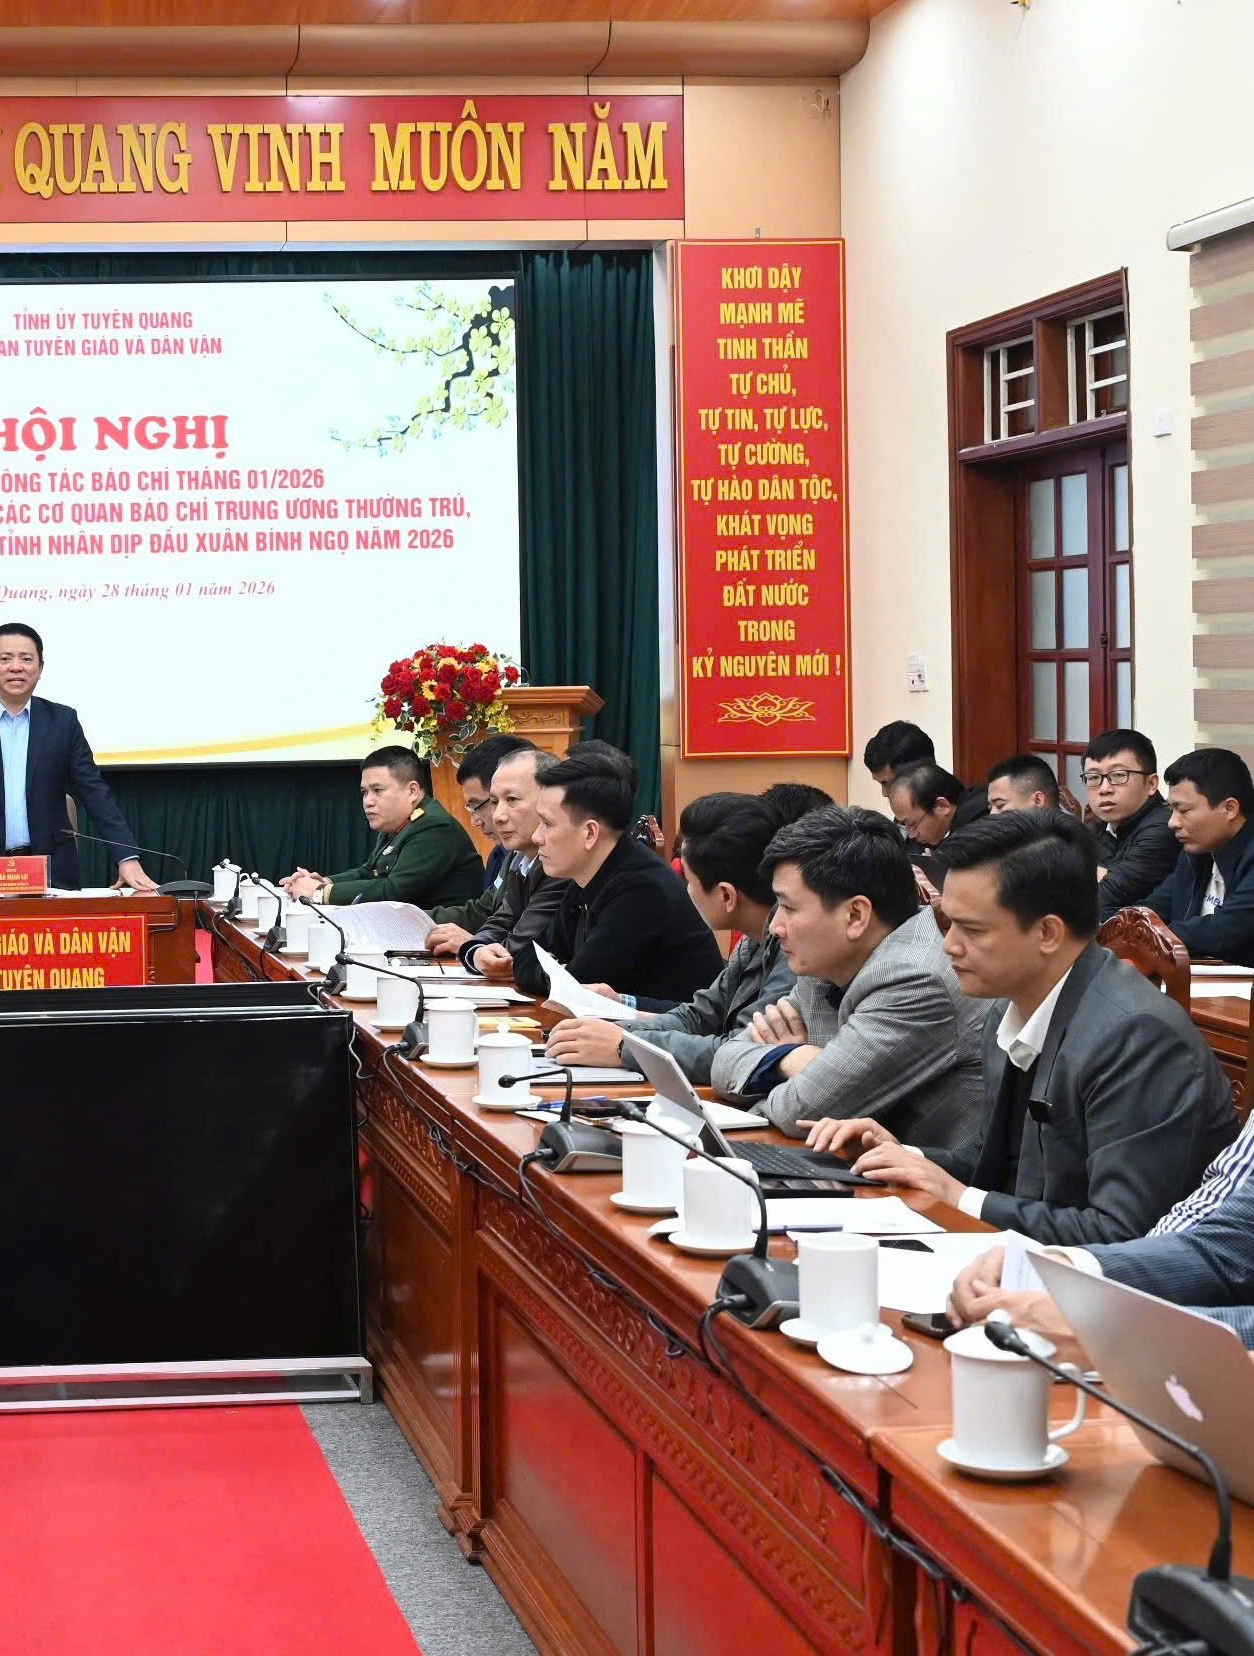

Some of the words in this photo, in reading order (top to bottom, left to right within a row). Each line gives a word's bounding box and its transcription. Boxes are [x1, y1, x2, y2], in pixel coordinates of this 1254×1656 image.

[15, 120, 194, 198] QUANG
[206, 122, 346, 192] VINH
[370, 99, 524, 192] MUÔN
[549, 103, 668, 191] NĂM
[722, 266, 762, 289] KHƠI
[768, 264, 801, 293] DẬY
[14, 308, 51, 330] TỈNH
[56, 307, 75, 330] ỦY
[82, 309, 134, 330] TUYÊN
[139, 311, 193, 331] QUANG
[720, 303, 772, 328] MẠNH
[778, 298, 804, 324] MẼ
[25, 336, 76, 356] TUYÊN
[151, 335, 185, 355] DÂN
[190, 334, 222, 358] VẬN
[717, 338, 757, 360] TINH
[762, 329, 808, 359] THẦN
[730, 371, 753, 399] TỰ
[757, 364, 796, 397] CHỦ,
[698, 407, 722, 434] TỰ
[725, 409, 758, 432] TIN,
[764, 407, 787, 433] TỰ
[791, 406, 828, 433] LỰC,
[93, 415, 229, 459] NGHỊ
[718, 442, 741, 469] TỰ
[745, 437, 809, 468] CƯỜNG,
[48, 468, 84, 493] TÁC
[91, 467, 130, 492] BÁO
[138, 466, 170, 491] CHÍ
[176, 466, 241, 490] THÁNG
[247, 468, 325, 490] 01/2026
[691, 478, 714, 504] TỰ
[718, 473, 752, 500] HÀO
[759, 473, 794, 500] DÂN
[799, 473, 837, 504] TỘC,
[38, 502, 64, 524] CƠ
[71, 503, 124, 525] QUAN
[130, 499, 169, 522] BÁO
[175, 497, 208, 521] CHÍ
[215, 500, 279, 520] TRUNG
[286, 498, 339, 520] ƯƠNG
[717, 509, 761, 536] KHÁT
[766, 514, 813, 540] VỌNG
[48, 531, 104, 555] NHÂN
[110, 534, 143, 558] DỊP
[196, 528, 249, 552] XUÂN
[309, 530, 349, 555] NGỌ
[356, 527, 401, 550] NĂM
[408, 528, 454, 549] 2026
[716, 545, 760, 571] PHÁT
[765, 543, 815, 570] TRIỂN
[102, 584, 122, 598] 28
[175, 583, 192, 596] 01
[199, 583, 236, 596] năm
[238, 580, 274, 595] 2026
[723, 577, 755, 606] ĐẤT
[762, 580, 808, 606] NƯỚC
[738, 620, 795, 641] TRONG
[693, 647, 714, 677] KỶ
[720, 650, 790, 677] NGUYÊN
[796, 649, 829, 676] MỚI
[34, 928, 54, 954] VÀ
[60, 927, 93, 954] DÂN
[98, 927, 130, 957] VẬN
[50, 967, 106, 989] QUANG
